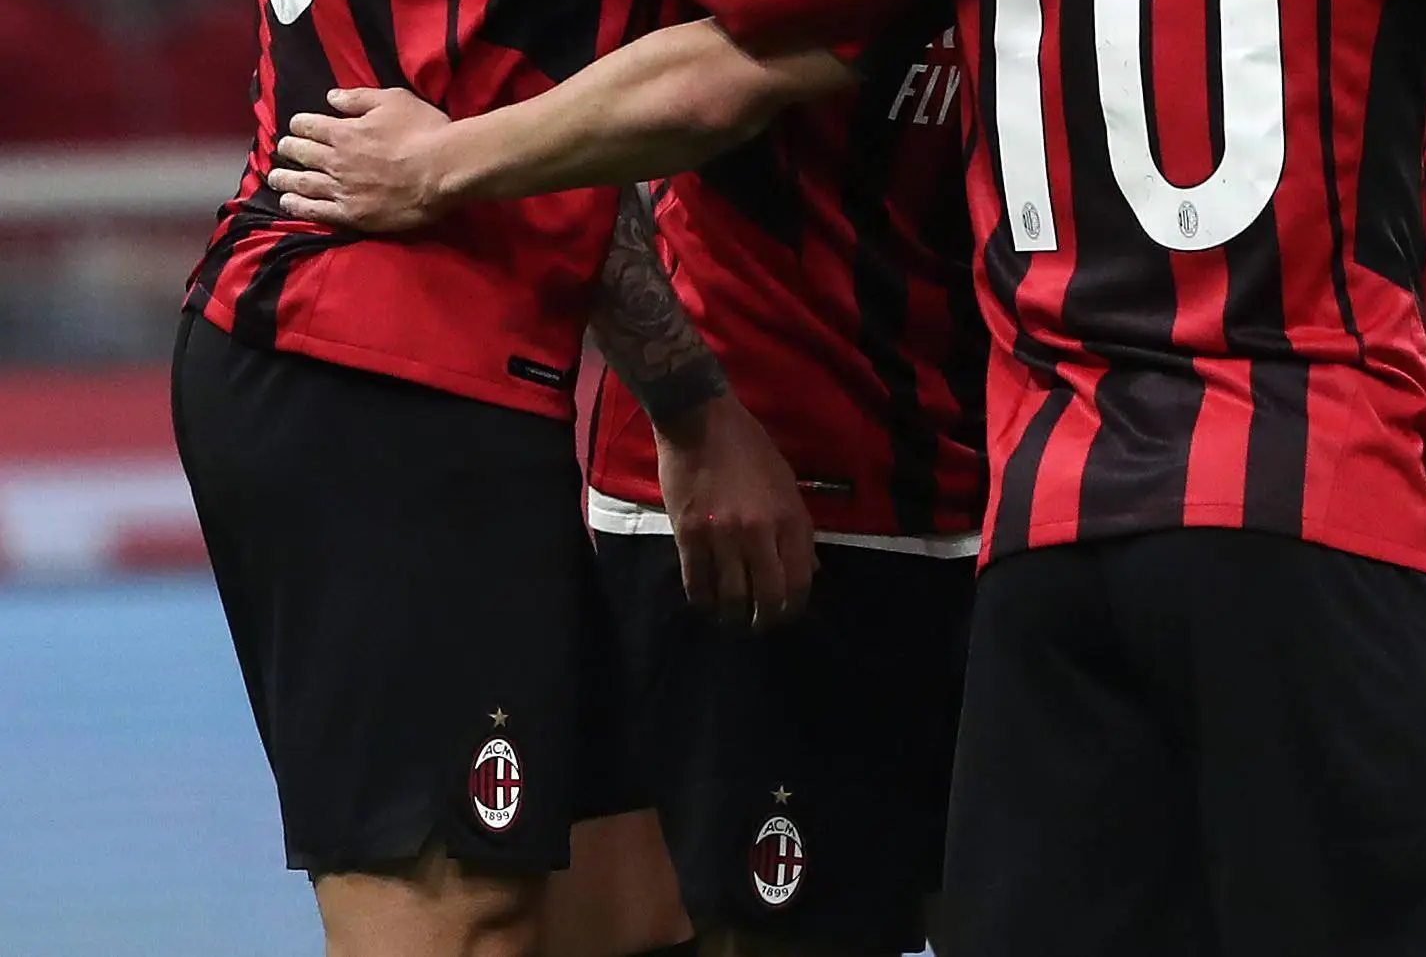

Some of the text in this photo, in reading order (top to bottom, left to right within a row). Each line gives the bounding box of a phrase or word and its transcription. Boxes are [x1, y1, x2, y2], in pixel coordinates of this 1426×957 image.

[888, 64, 960, 125] FLY
[483, 741, 512, 759] ACM
[484, 810, 510, 821] 1899
[763, 819, 796, 837] ACM
[762, 885, 789, 898] 1899
